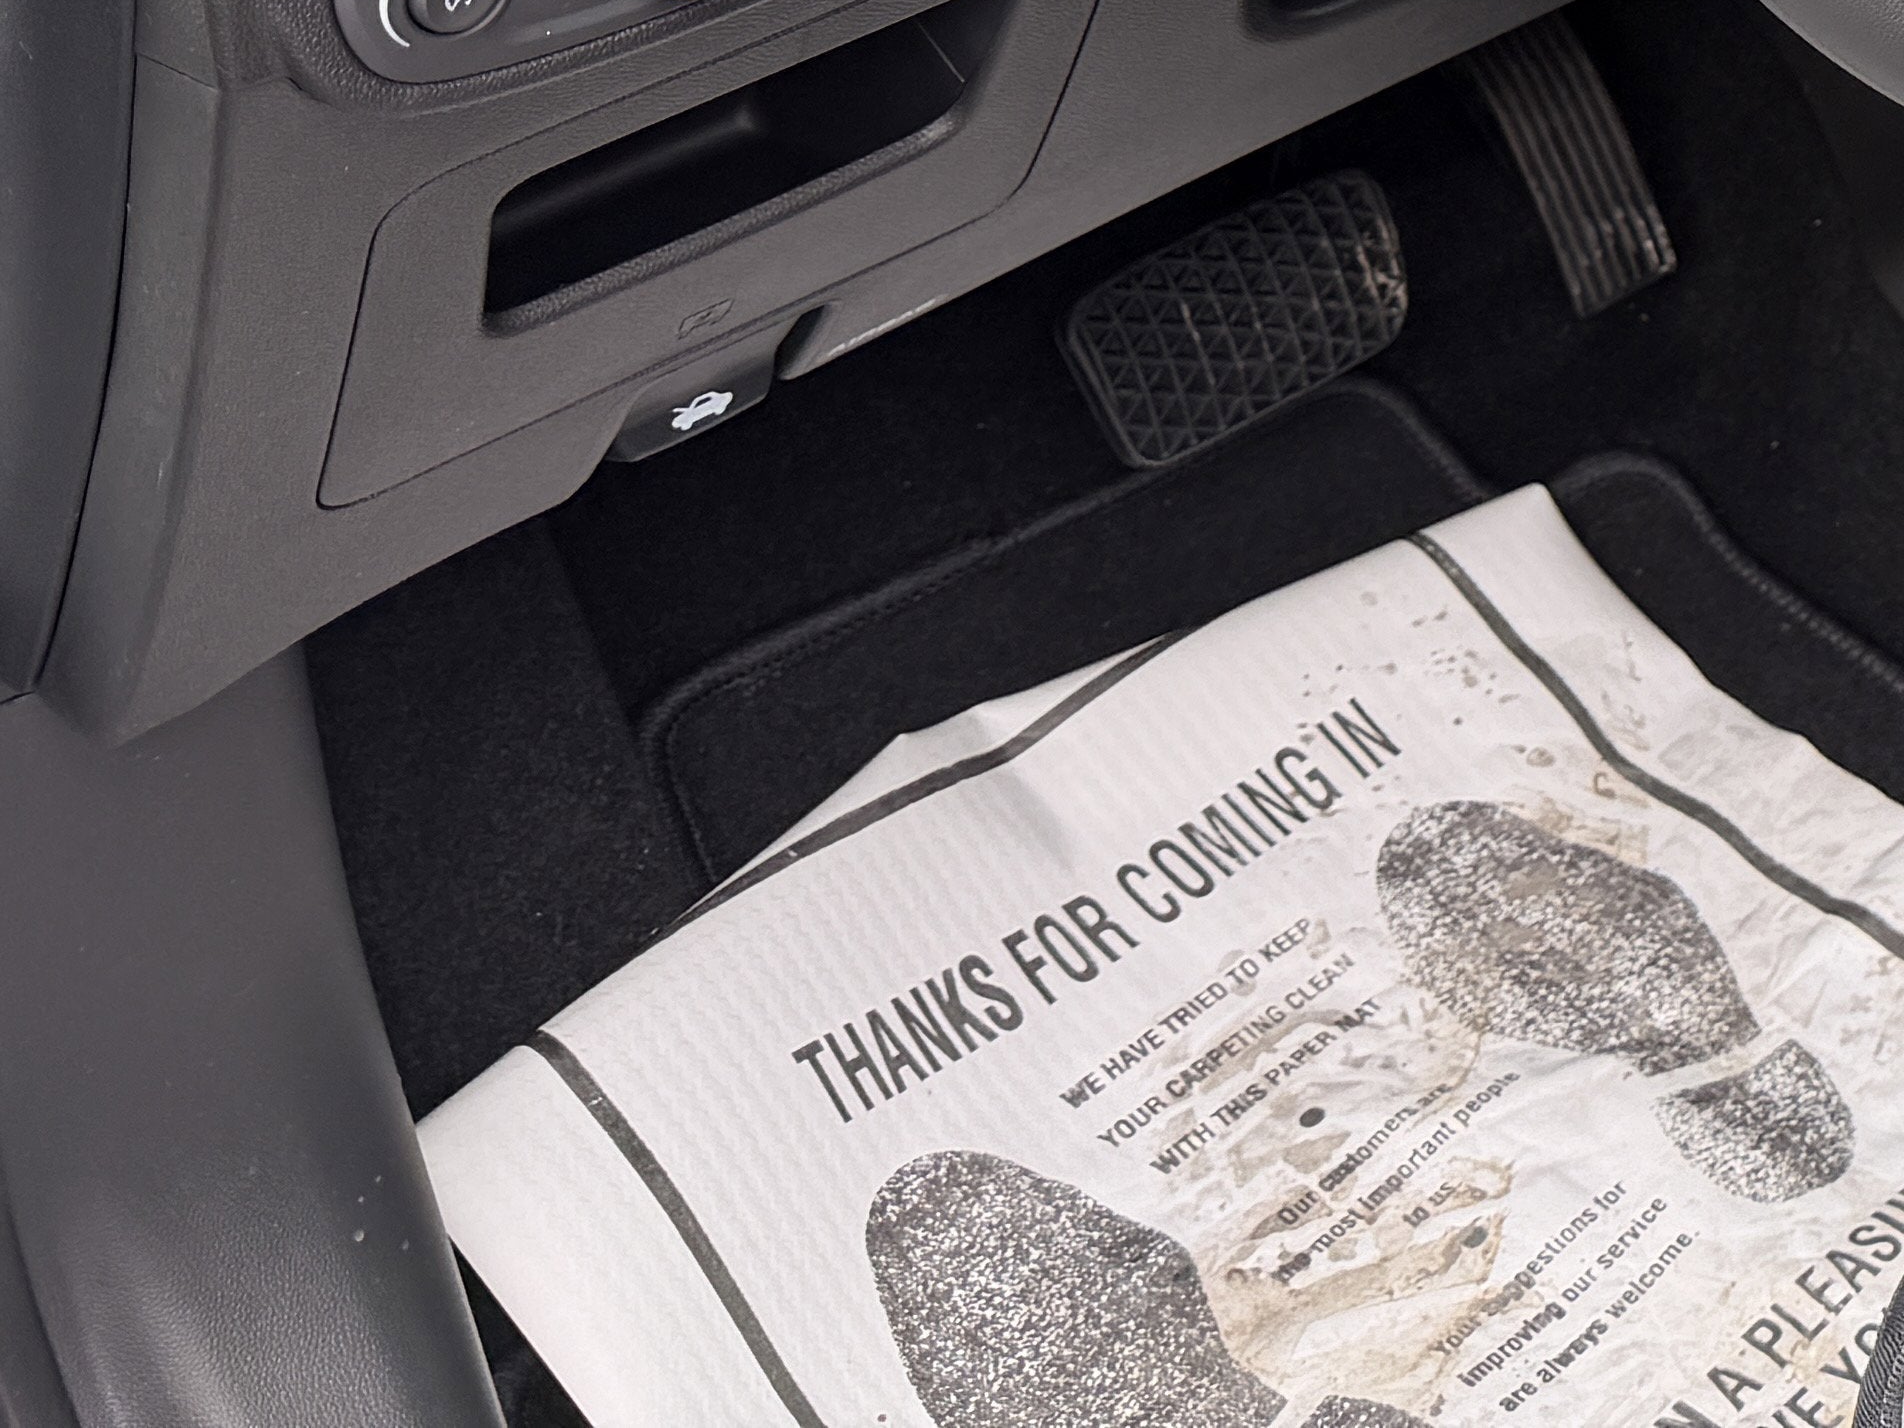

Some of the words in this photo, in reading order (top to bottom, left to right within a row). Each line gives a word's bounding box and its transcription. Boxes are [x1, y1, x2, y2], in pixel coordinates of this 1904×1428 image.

[792, 955, 1024, 1123] THANKS
[1001, 895, 1140, 1005] FOR
[1116, 746, 1343, 923] COMING
[1317, 697, 1402, 778] IN
[1059, 1071, 1105, 1109] WE
[1100, 1028, 1165, 1080] HAVE
[1158, 981, 1228, 1034] TRIED
[1226, 958, 1260, 987] TO
[1258, 917, 1311, 962] KEEP
[1097, 1095, 1167, 1148] YOUR
[1165, 1005, 1286, 1099] CARPETING
[1285, 953, 1354, 1011] CLEAN
[1150, 1123, 1216, 1175] WITH
[1210, 1083, 1268, 1127] THIS
[1264, 1029, 1337, 1086] PAPER
[1334, 998, 1381, 1032] MAT
[1277, 1190, 1319, 1226] Our
[1317, 1104, 1417, 1192] customers
[1416, 1083, 1452, 1107] are
[1310, 1207, 1365, 1255] most
[1358, 1121, 1456, 1213] important
[1452, 1072, 1521, 1129] people
[1403, 1205, 1430, 1229] to
[1430, 1315, 1482, 1356] Your
[1593, 1180, 1628, 1212] for
[1457, 1301, 1567, 1388] improving
[1562, 1267, 1597, 1303] our
[1596, 1197, 1667, 1270] service
[1499, 1381, 1538, 1412] are
[1536, 1317, 1609, 1384] always
[1605, 1230, 1701, 1320] welcome.
[1706, 1366, 1763, 1412] A
